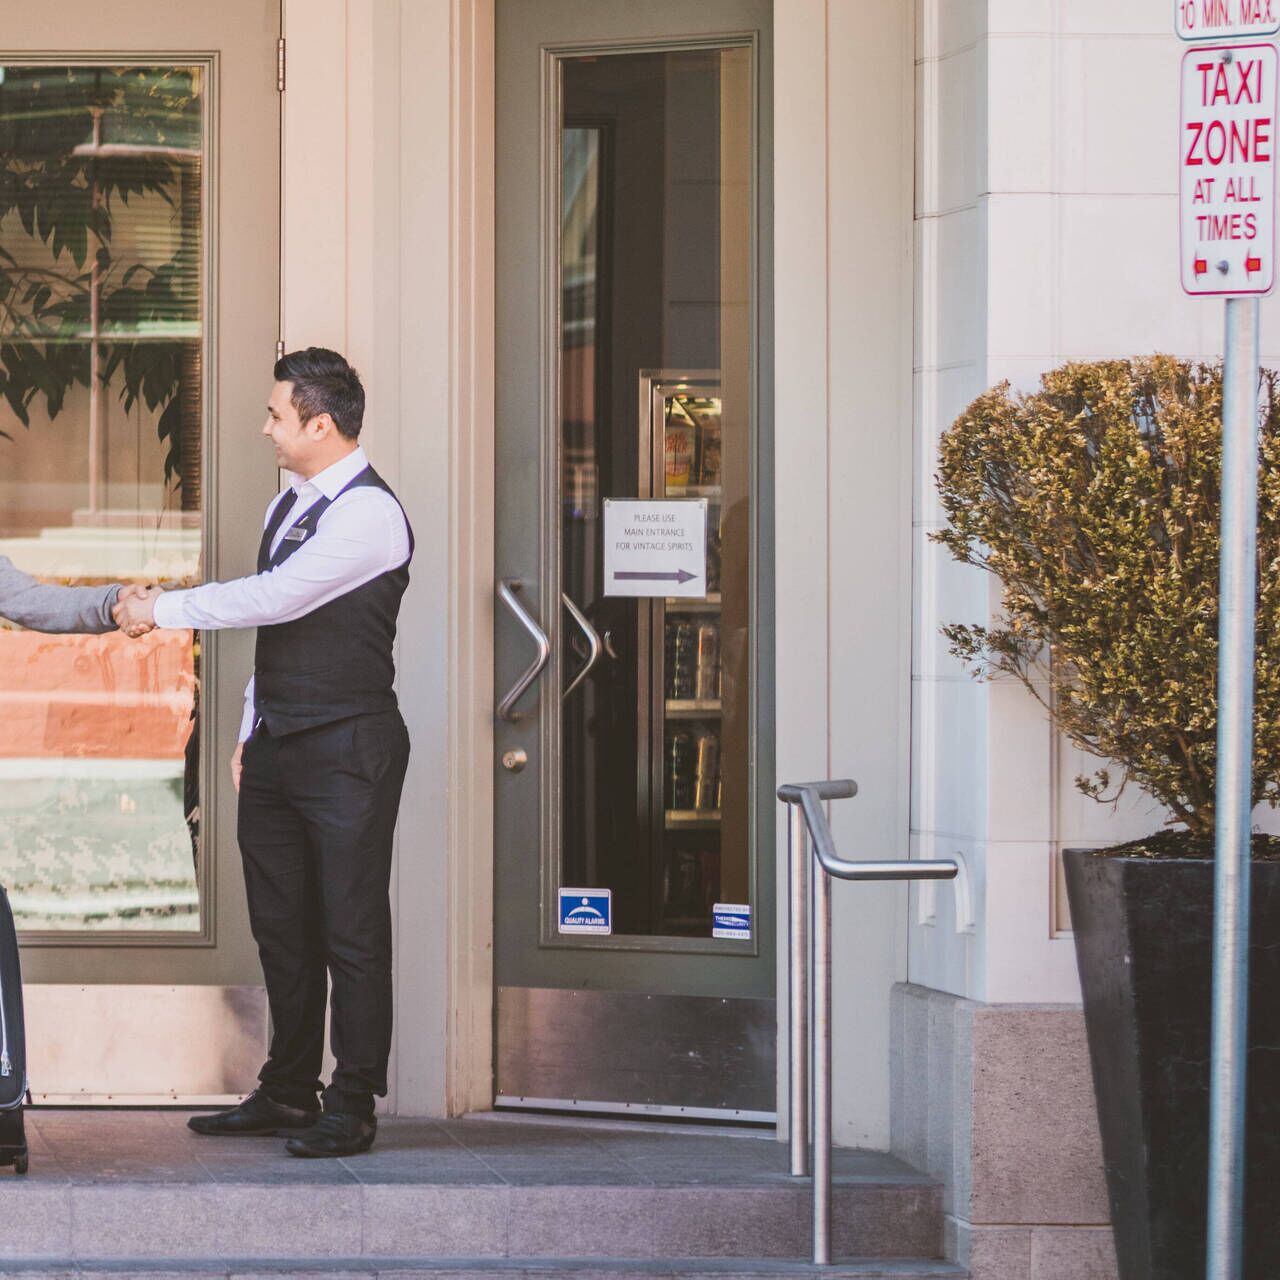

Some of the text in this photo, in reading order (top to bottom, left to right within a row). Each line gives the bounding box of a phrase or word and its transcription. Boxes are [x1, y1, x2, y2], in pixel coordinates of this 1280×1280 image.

[1180, 0, 1195, 30] 10
[1196, 59, 1263, 107] TAXI
[1185, 118, 1271, 166] ZONE
[1192, 176, 1261, 205] AT ALL
[1195, 213, 1257, 241] TIMES
[624, 528, 685, 537] MAIN ENTRANCE
[634, 514, 676, 523] PLEASE USE
[616, 542, 693, 552] FOR VINTAGE SPIRITS
